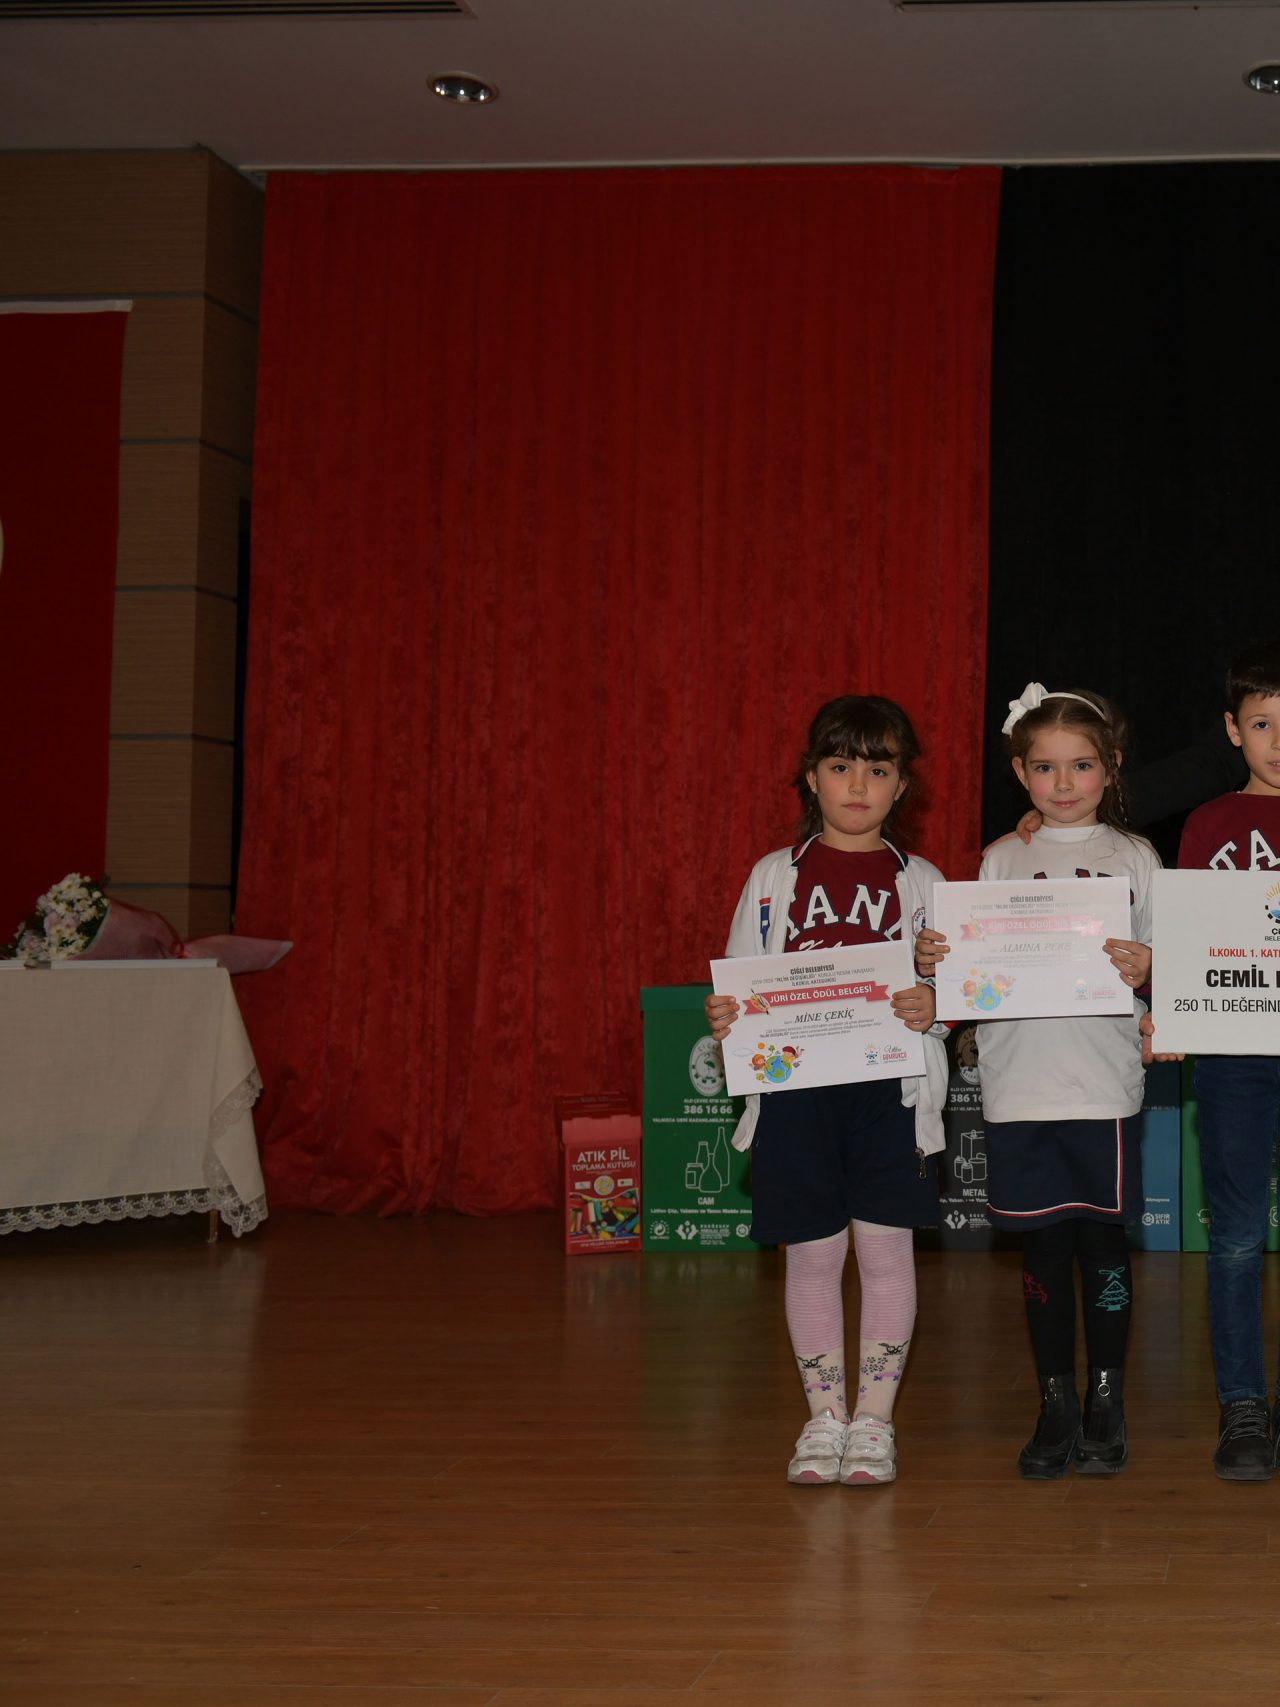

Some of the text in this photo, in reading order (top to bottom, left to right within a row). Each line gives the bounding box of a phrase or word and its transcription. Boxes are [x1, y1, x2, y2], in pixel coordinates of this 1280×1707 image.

[1000, 941, 1040, 953] ALMİNA
[1209, 947, 1247, 958] İLKOKUL
[1250, 949, 1258, 958] 1.
[1206, 964, 1269, 988] CEMİL
[770, 985, 872, 1003] JÜRİ ÖZEL ÖDÜL BELGESİ
[1174, 998, 1198, 1012] 250
[1202, 999, 1218, 1012] TL
[794, 1008, 855, 1023] MİNE ÇEKİÇ
[950, 1094, 970, 1103] 386
[683, 1105, 733, 1114] 386 16 66
[577, 1147, 630, 1163] ATIK PİL
[572, 1160, 636, 1172] TOPLAMA KUTUSU
[962, 1188, 988, 1196] METAL
[697, 1197, 715, 1206] CAM
